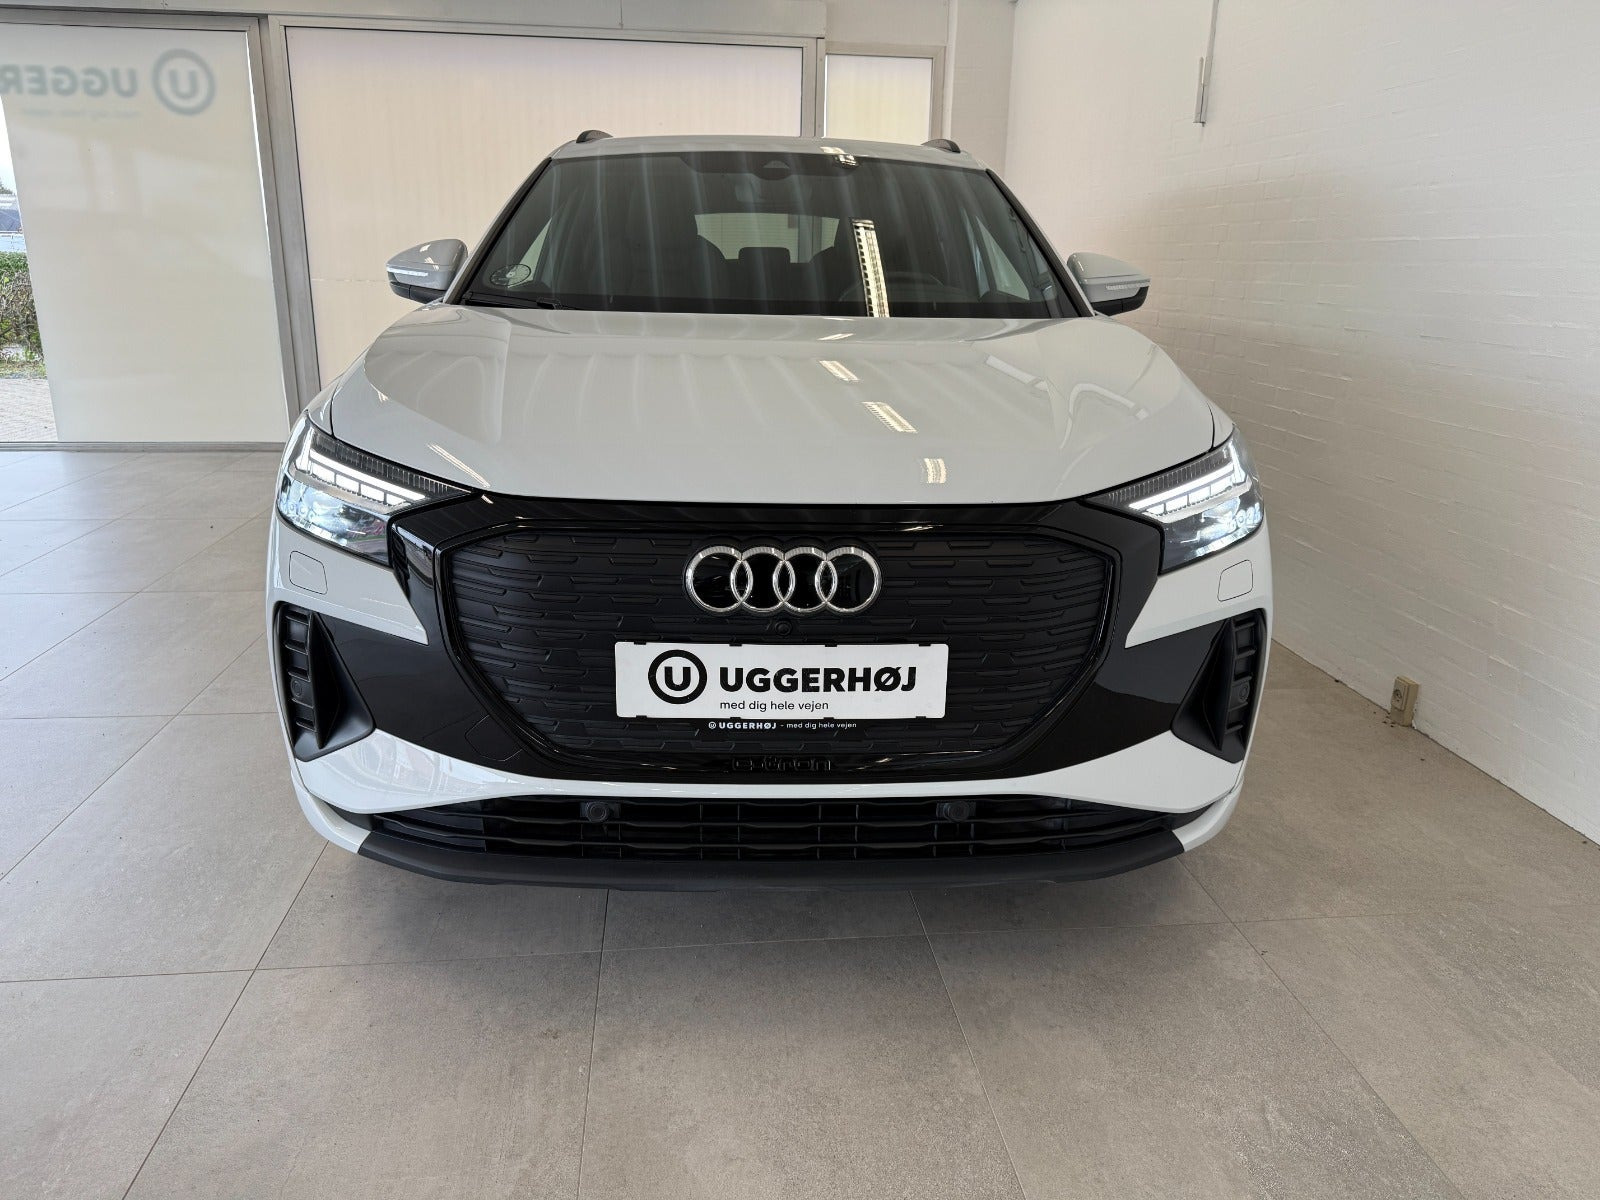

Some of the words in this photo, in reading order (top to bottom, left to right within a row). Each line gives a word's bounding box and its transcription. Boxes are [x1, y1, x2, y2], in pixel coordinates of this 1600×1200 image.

[719, 666, 917, 693] UGGERHØJ
[719, 700, 746, 710] med
[748, 700, 767, 713] dig
[770, 700, 795, 711] hele
[797, 700, 829, 713] vejen
[718, 721, 777, 730] UGGERHØJ
[786, 721, 803, 729] med
[804, 721, 817, 730] dig
[818, 721, 835, 729] hele
[836, 721, 857, 730] vejen
